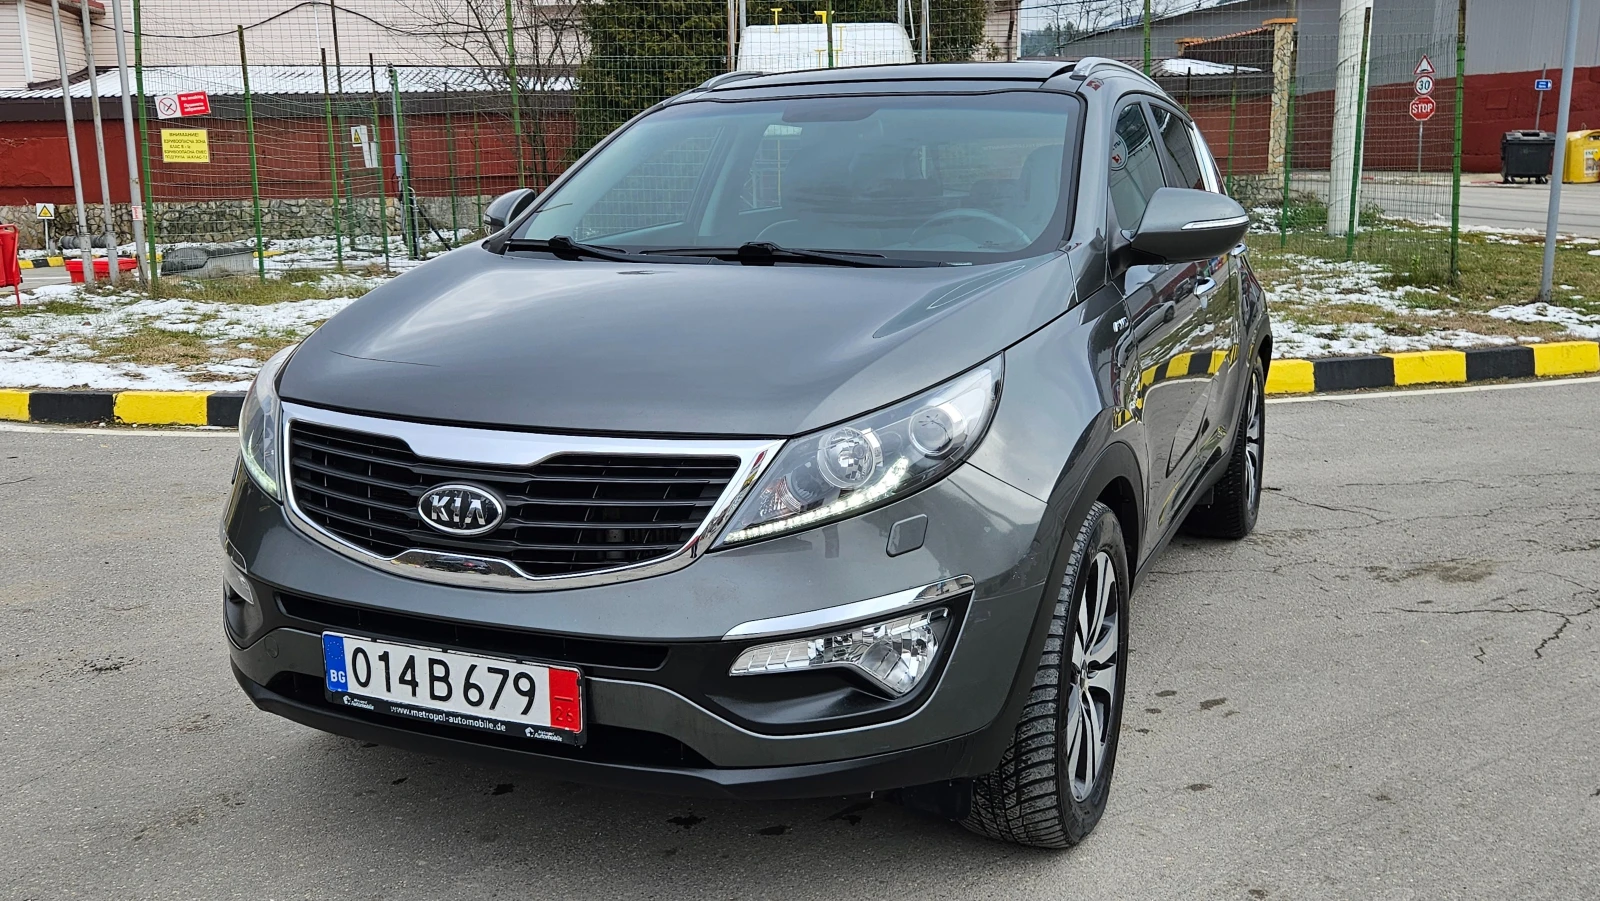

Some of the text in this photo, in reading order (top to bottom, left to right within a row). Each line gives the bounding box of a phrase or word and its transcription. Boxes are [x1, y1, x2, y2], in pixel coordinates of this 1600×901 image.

[1418, 80, 1430, 91] 30
[1412, 103, 1433, 113] STOP
[430, 494, 486, 525] KIA
[330, 670, 346, 684] BG
[390, 705, 506, 732] www.metropol-automobile.de
[554, 706, 574, 722] 26
